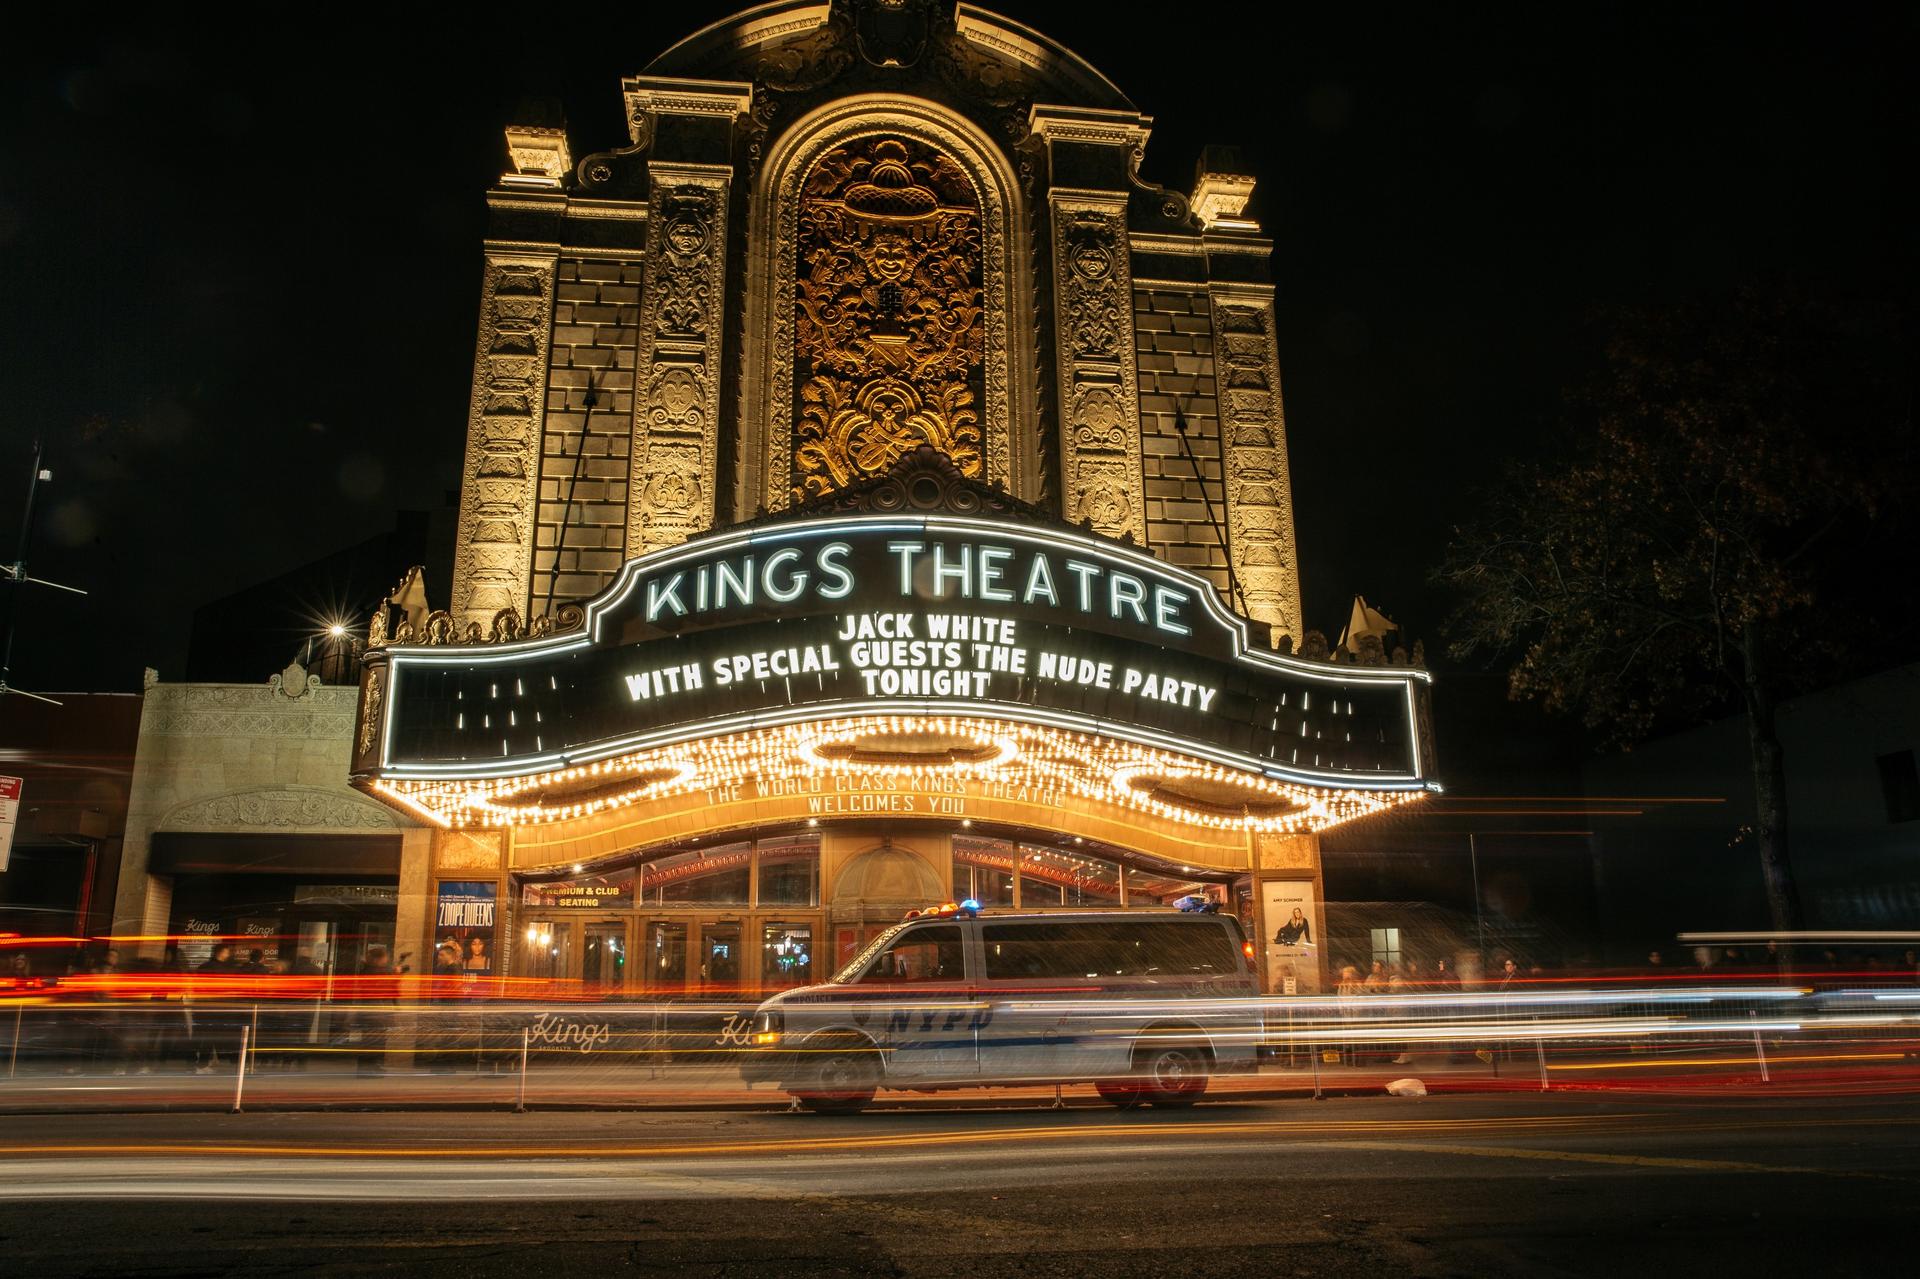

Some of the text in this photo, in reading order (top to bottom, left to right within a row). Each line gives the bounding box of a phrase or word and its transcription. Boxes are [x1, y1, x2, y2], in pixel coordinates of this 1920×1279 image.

[646, 541, 1192, 636] KINGS THEATRE
[839, 613, 1016, 645] JACK WHITE
[625, 641, 1217, 712] WITH SPECIAL GUESTS THE NUDE PARTY
[861, 669, 989, 697] TONIGHT
[705, 774, 1066, 808] THE WORLD CLASS KINGS THEATRE
[808, 794, 965, 814] WELCOMES YOU
[541, 887, 620, 896] PREMIUM & CLUB
[559, 898, 599, 907] SEATING
[438, 902, 495, 927] 2 DOPE QUEENS
[185, 919, 220, 936] Kings
[244, 923, 275, 938] Kings
[887, 1008, 994, 1033] NYPD
[527, 1012, 610, 1055] Kings
